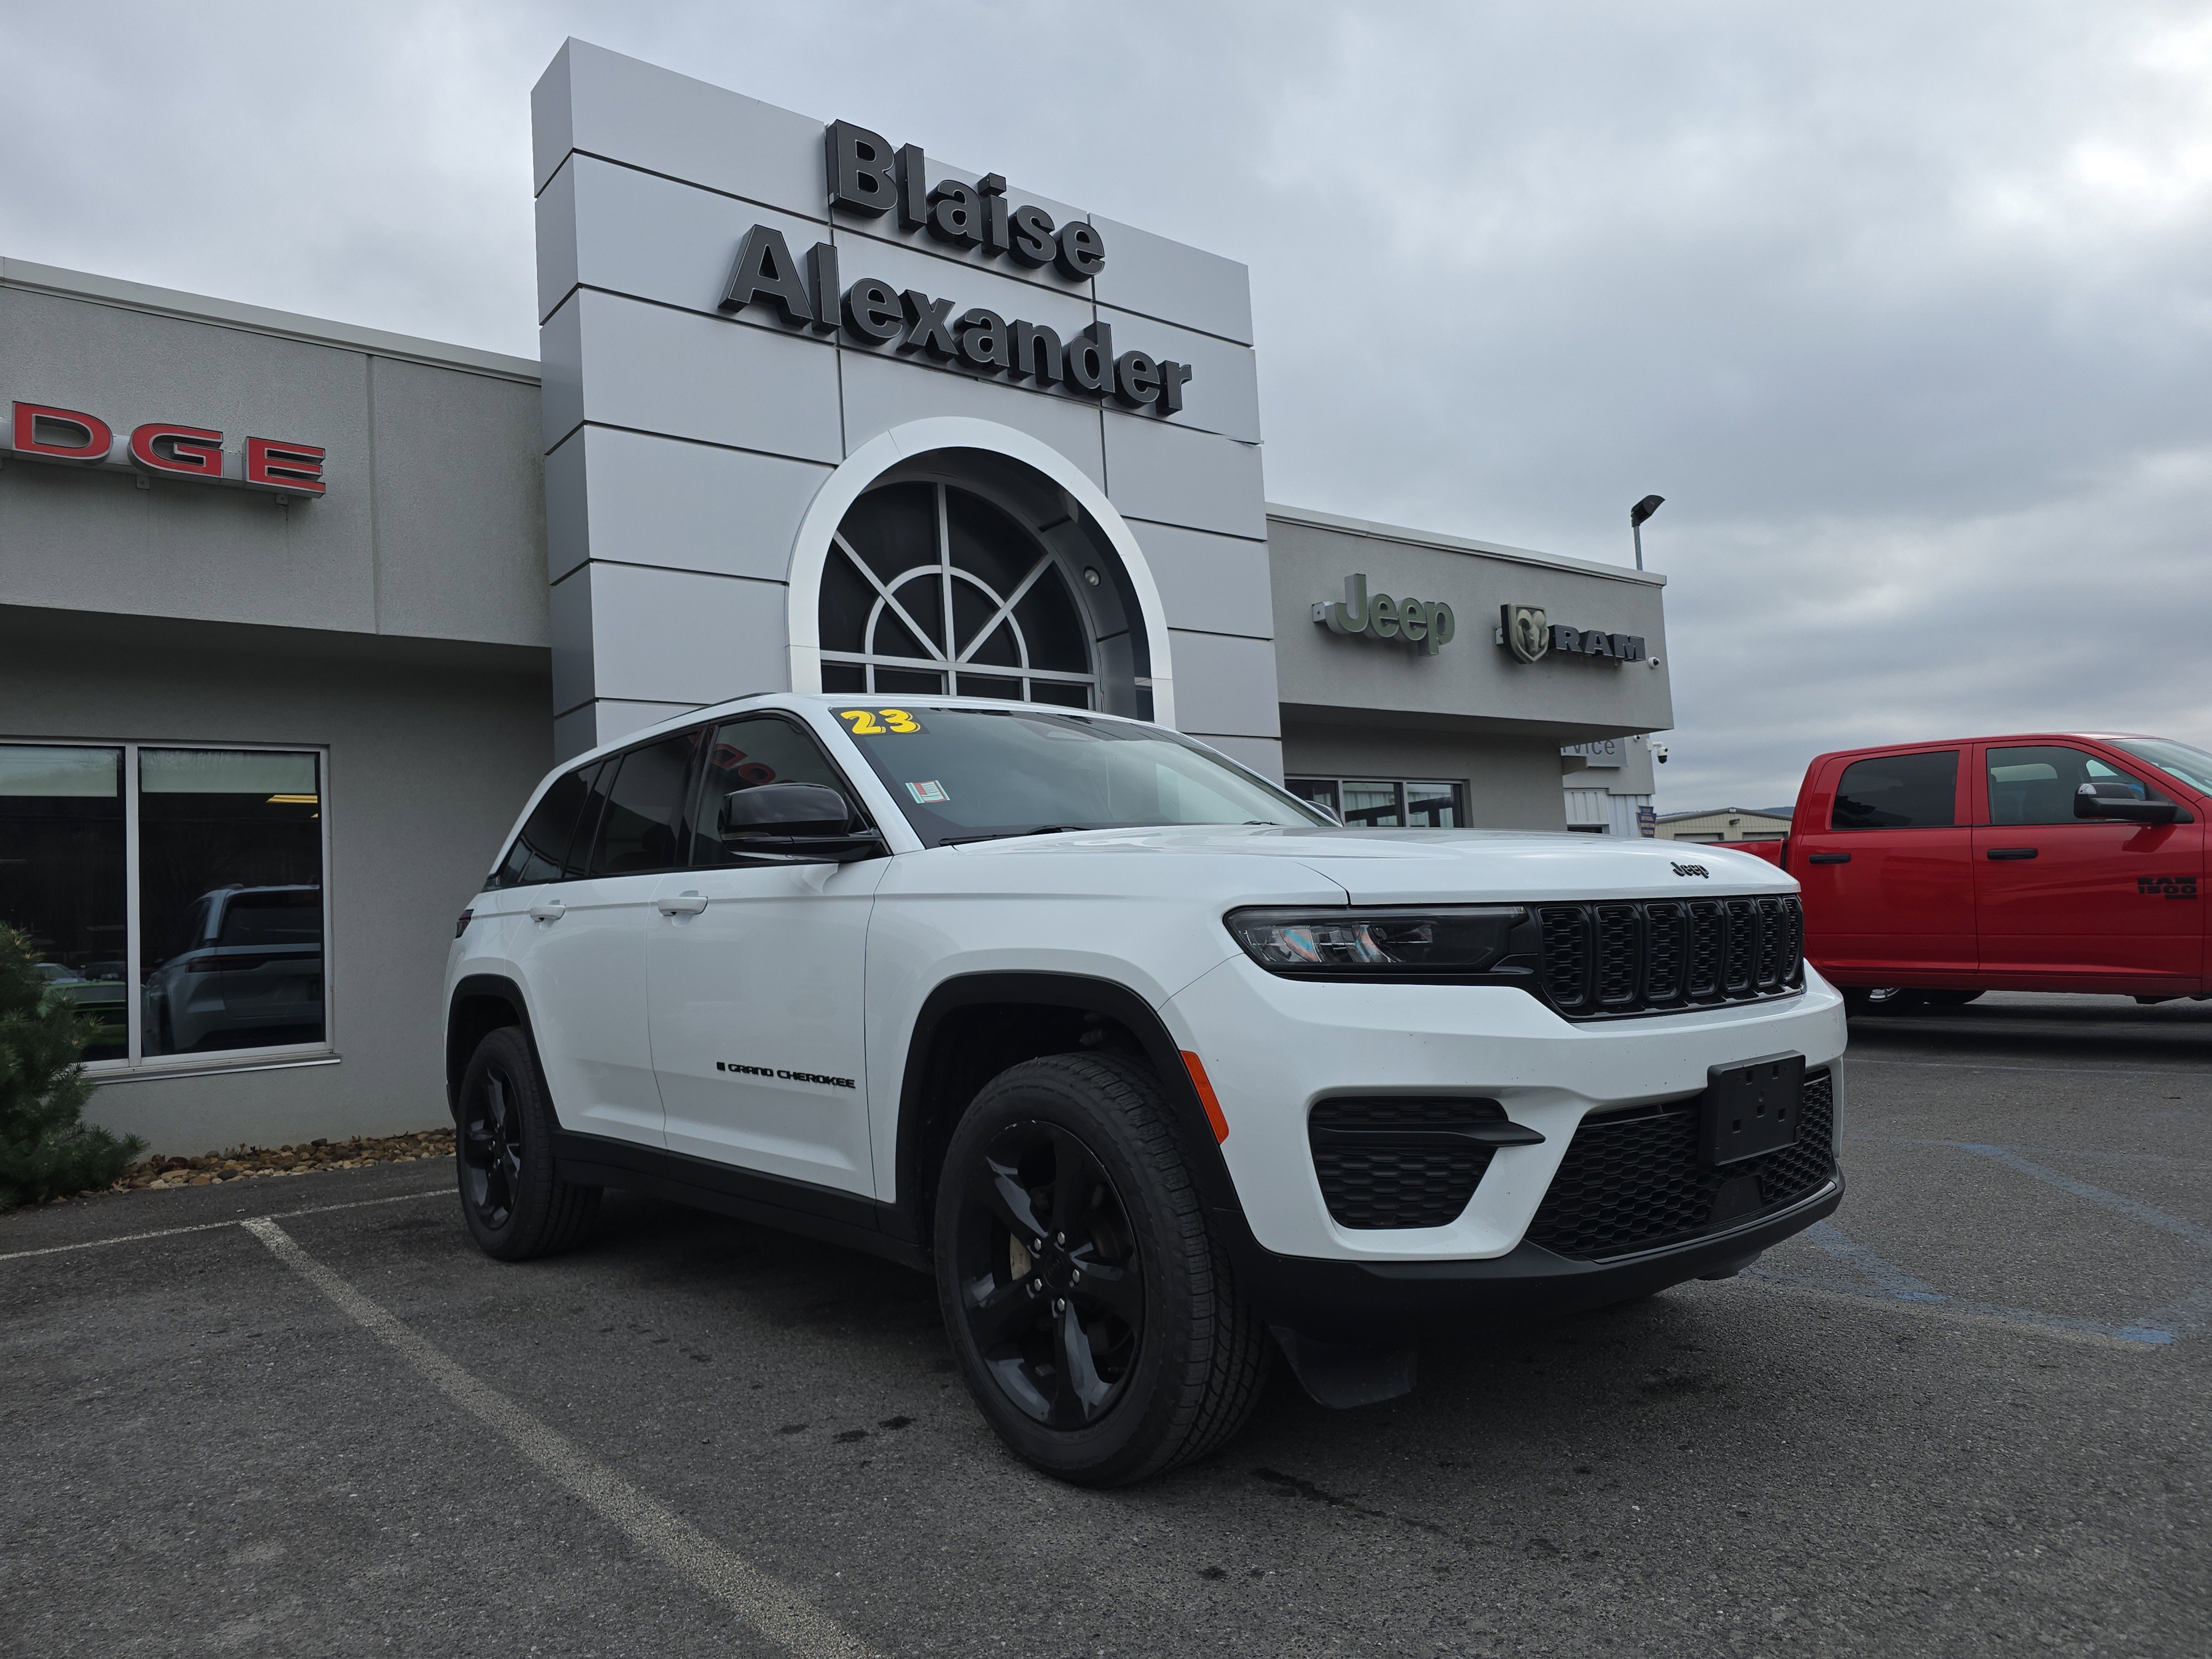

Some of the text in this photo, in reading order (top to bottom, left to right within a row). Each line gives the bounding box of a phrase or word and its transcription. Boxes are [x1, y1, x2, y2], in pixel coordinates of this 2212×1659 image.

[826, 119, 1105, 282] Blaise
[718, 224, 1192, 416] Alexander
[1325, 573, 1455, 656] Jeep
[1549, 625, 1646, 663] RAM
[840, 709, 921, 734] 23
[1670, 861, 1709, 879] Jeep
[2137, 877, 2197, 885] RAM
[2137, 885, 2197, 893] 1500
[728, 1064, 856, 1089] GRAND CHEROKEE
